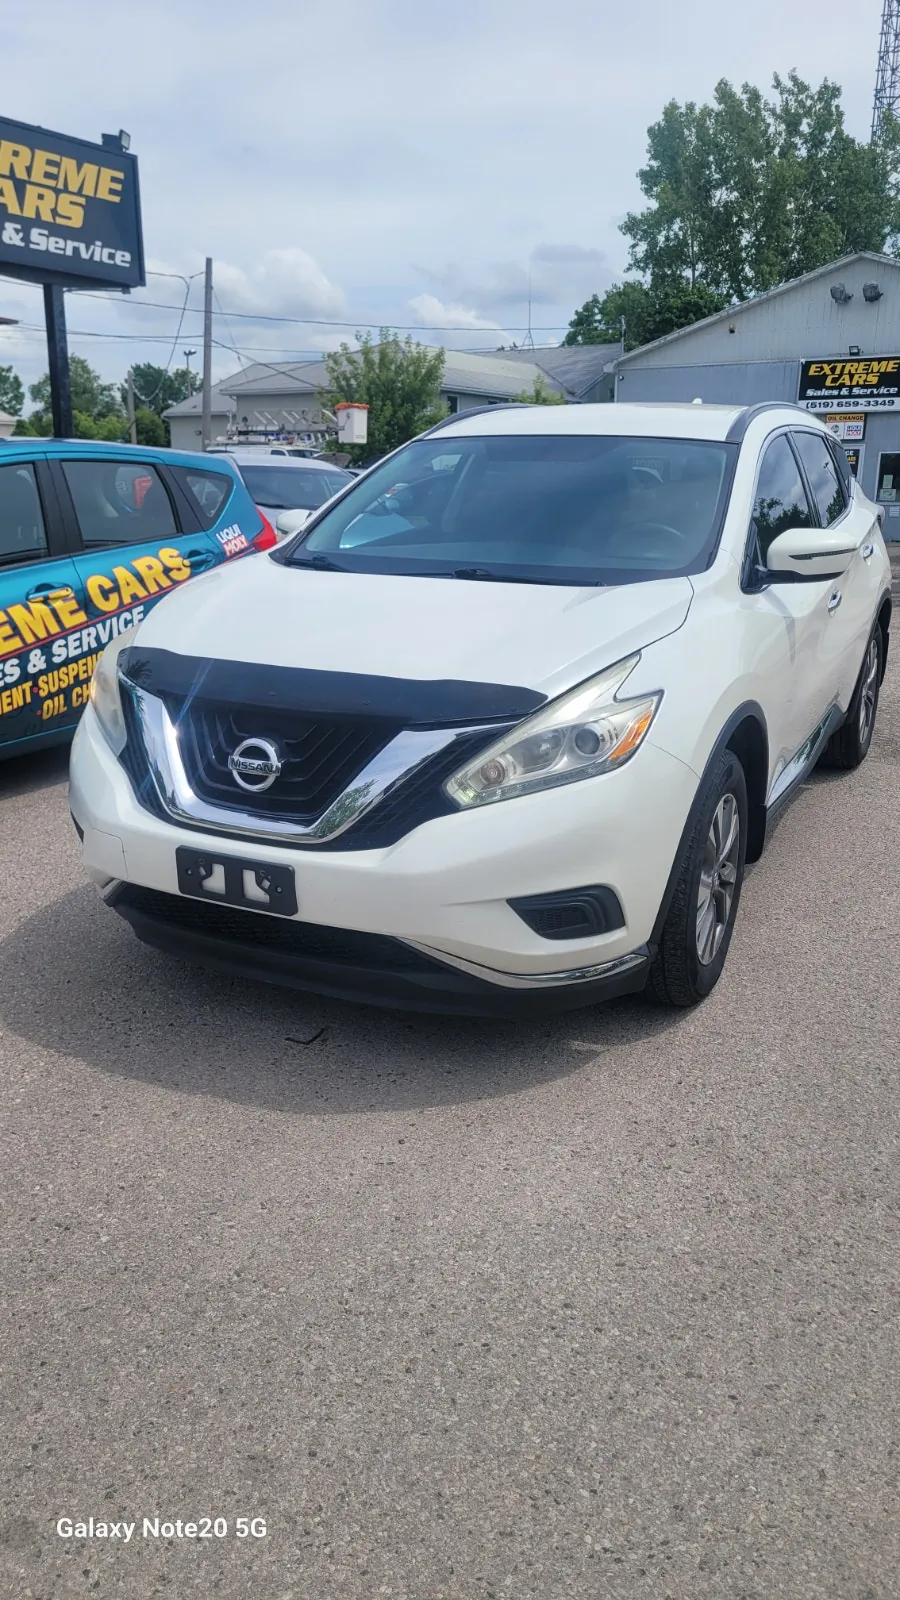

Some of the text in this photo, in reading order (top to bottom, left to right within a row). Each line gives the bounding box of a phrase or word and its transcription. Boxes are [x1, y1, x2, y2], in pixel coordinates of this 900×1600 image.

[0, 177, 86, 229] ARS
[2, 222, 131, 267] & Service
[808, 360, 900, 376] EXTREME
[805, 386, 898, 397] Sales & Service
[825, 373, 880, 387] CARS
[806, 400, 895, 410] (519) 659-3349
[215, 523, 242, 544] LIQUI
[222, 534, 249, 557] MOLY
[86, 547, 191, 612] CARS
[0, 605, 144, 687] S & SERVICE
[0, 681, 34, 716] ENT
[42, 693, 68, 720] OIL
[231, 758, 274, 774] NISSAN
